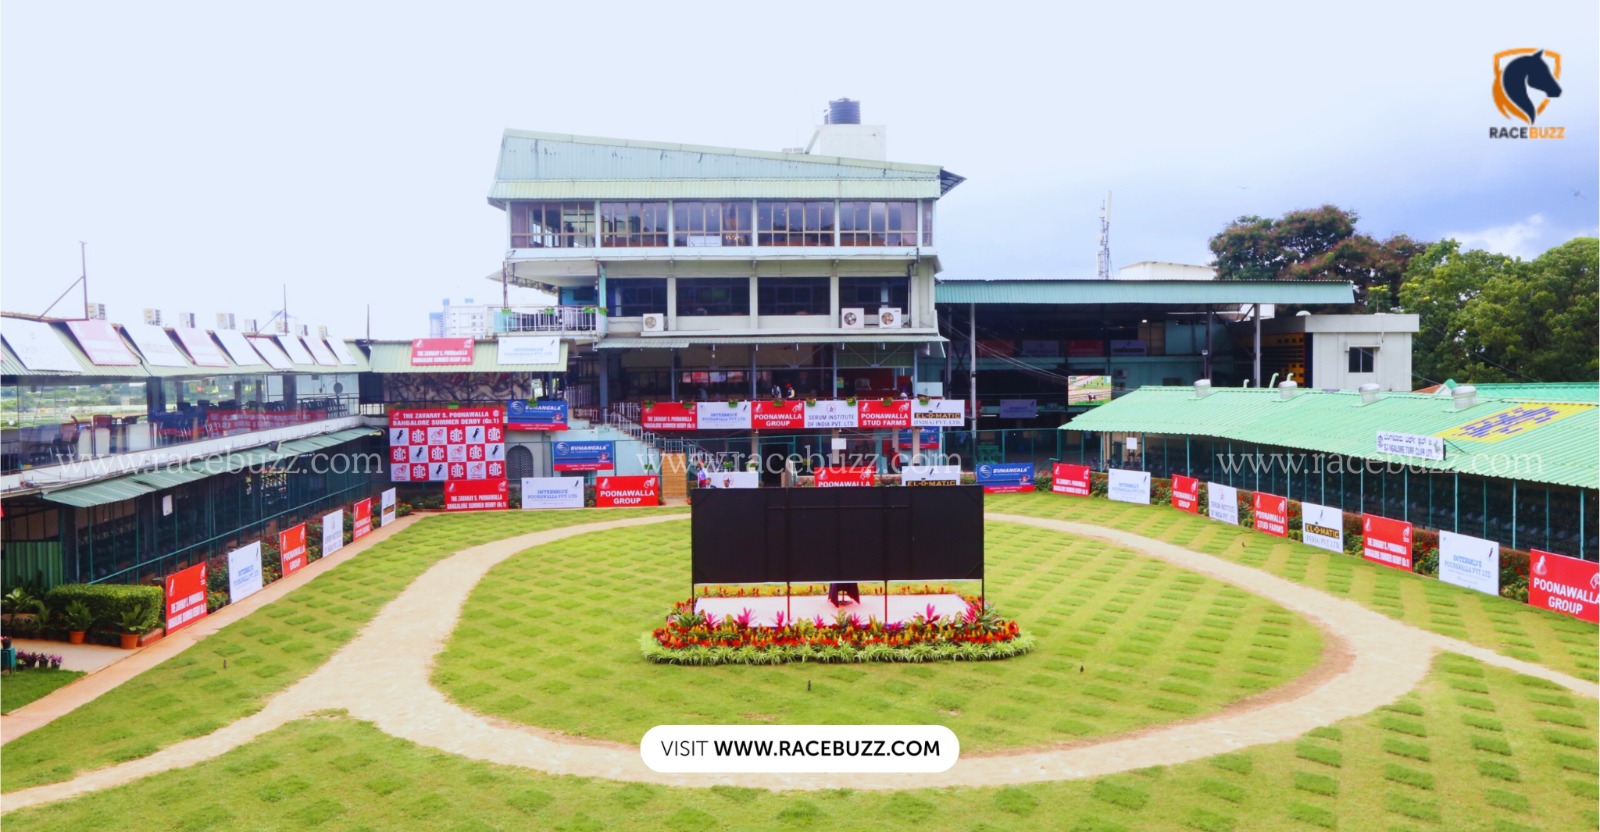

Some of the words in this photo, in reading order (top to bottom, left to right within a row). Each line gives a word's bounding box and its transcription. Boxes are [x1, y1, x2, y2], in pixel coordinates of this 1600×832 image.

[1256, 511, 1284, 524] POONAWALLA
[1257, 521, 1268, 529] STUD
[1269, 522, 1284, 534] FARMS
[1534, 577, 1599, 604] POONAWALLA
[1548, 596, 1583, 615] GROUP
